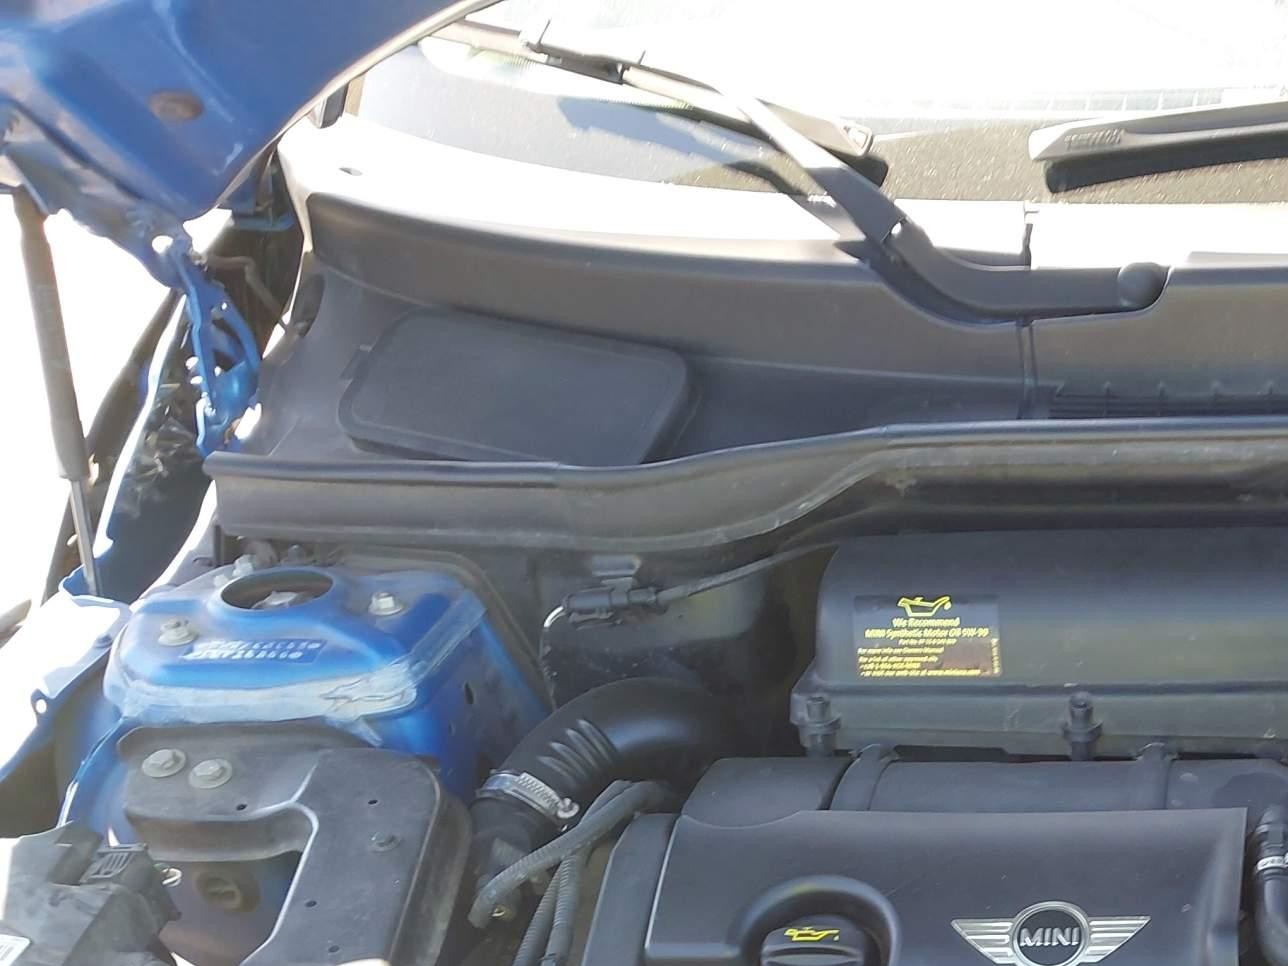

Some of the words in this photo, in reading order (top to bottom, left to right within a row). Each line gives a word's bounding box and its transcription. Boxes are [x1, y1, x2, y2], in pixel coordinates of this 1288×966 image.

[908, 616, 960, 628] Recommend
[886, 628, 922, 640] Synthetic
[923, 628, 948, 638] Motor
[1019, 927, 1080, 947] MINI
